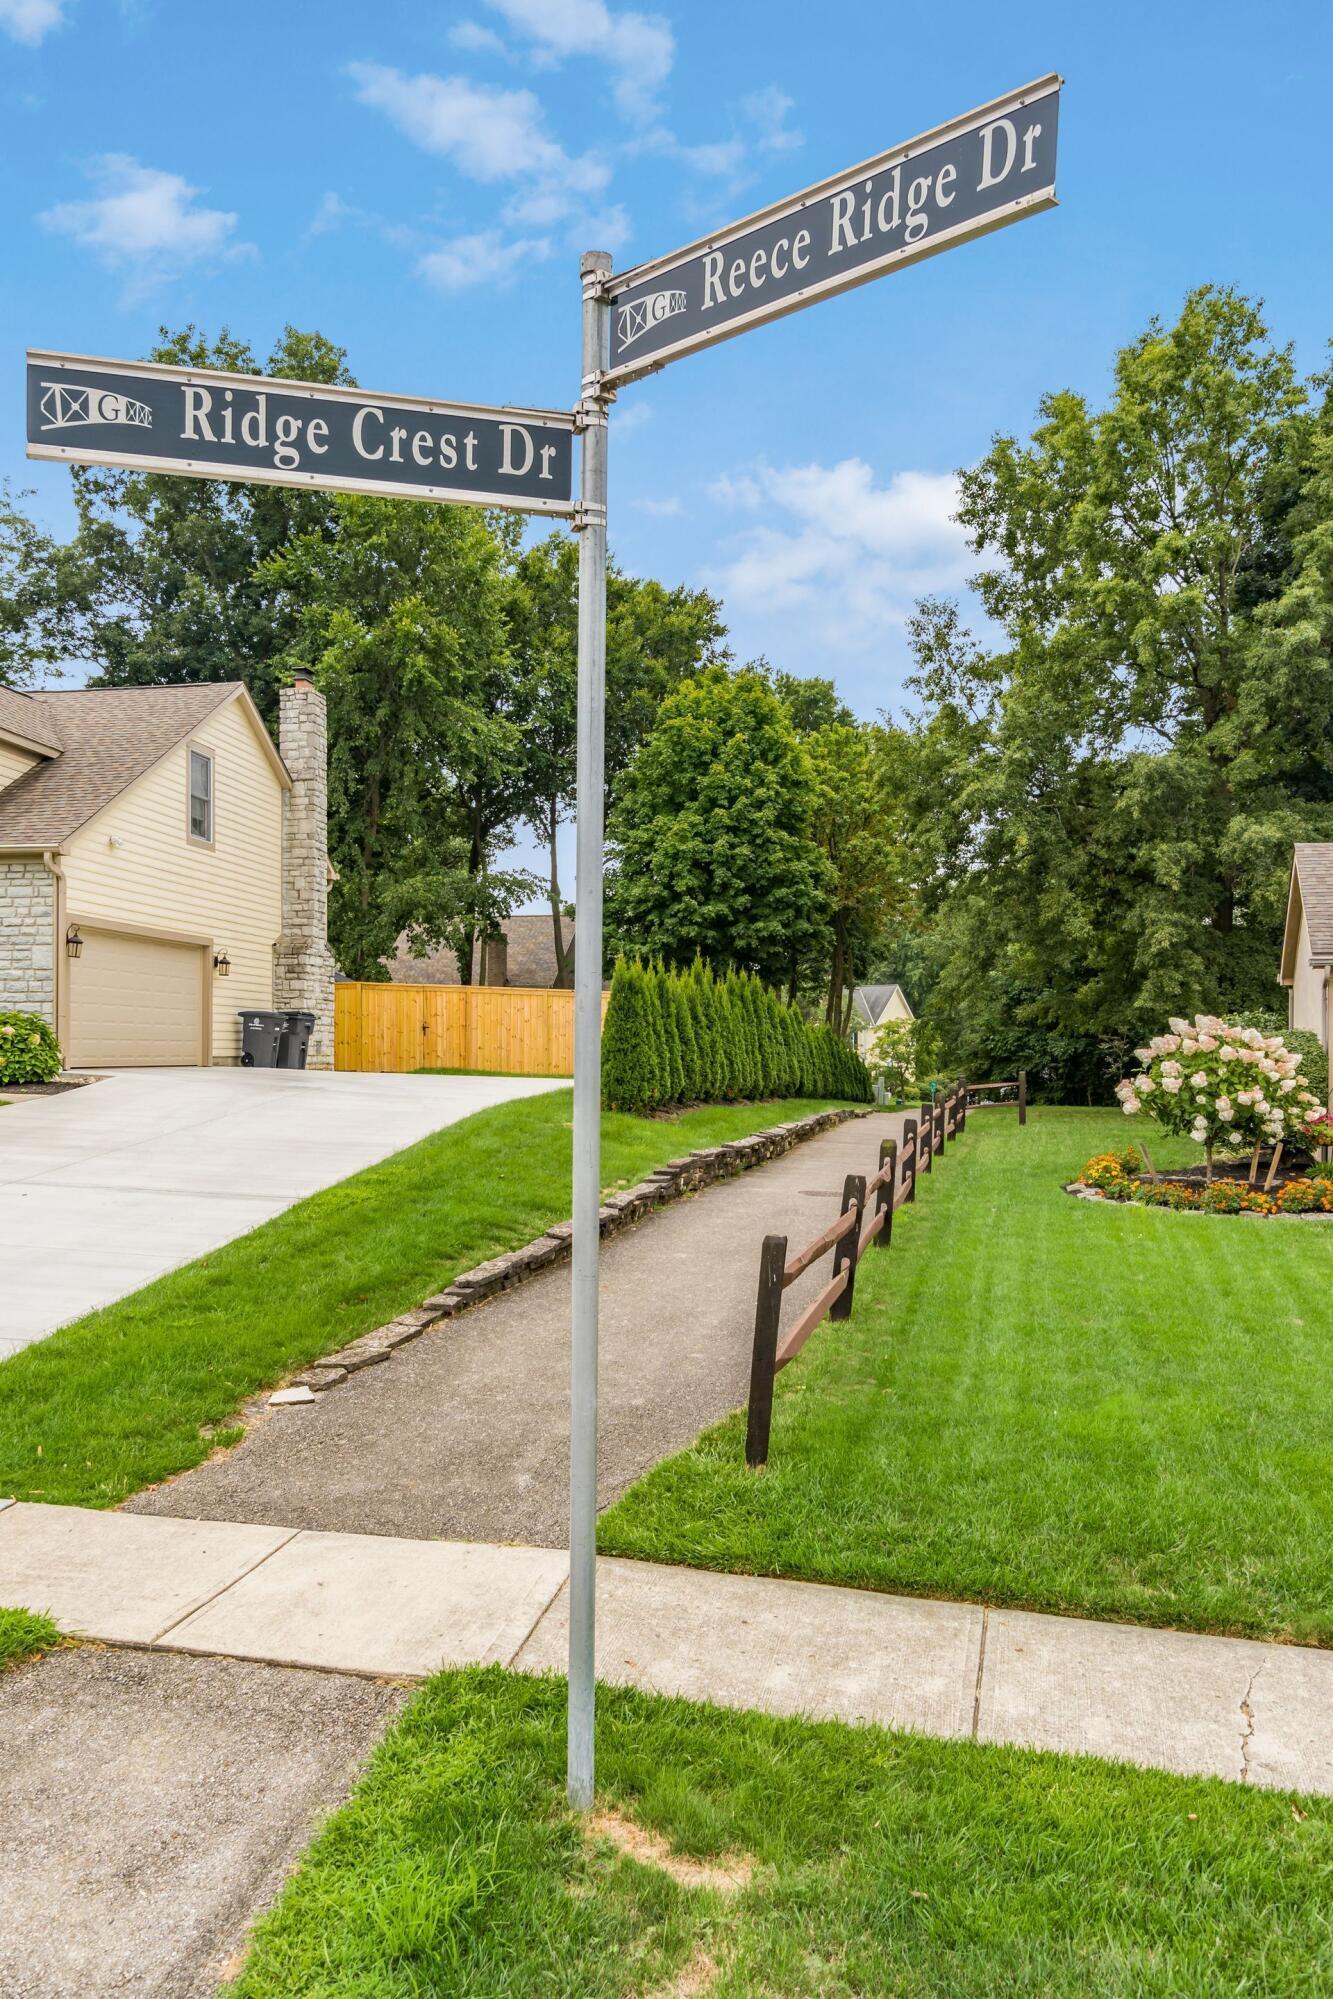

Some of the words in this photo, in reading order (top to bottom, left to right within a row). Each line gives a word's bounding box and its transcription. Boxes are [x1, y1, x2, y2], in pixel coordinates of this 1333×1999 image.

[700, 228, 812, 310] Reece
[827, 163, 957, 256] Ridge
[976, 118, 1042, 193] Dr
[179, 385, 329, 470] Ridge
[352, 406, 479, 472] Crest
[498, 424, 557, 480] Dr
